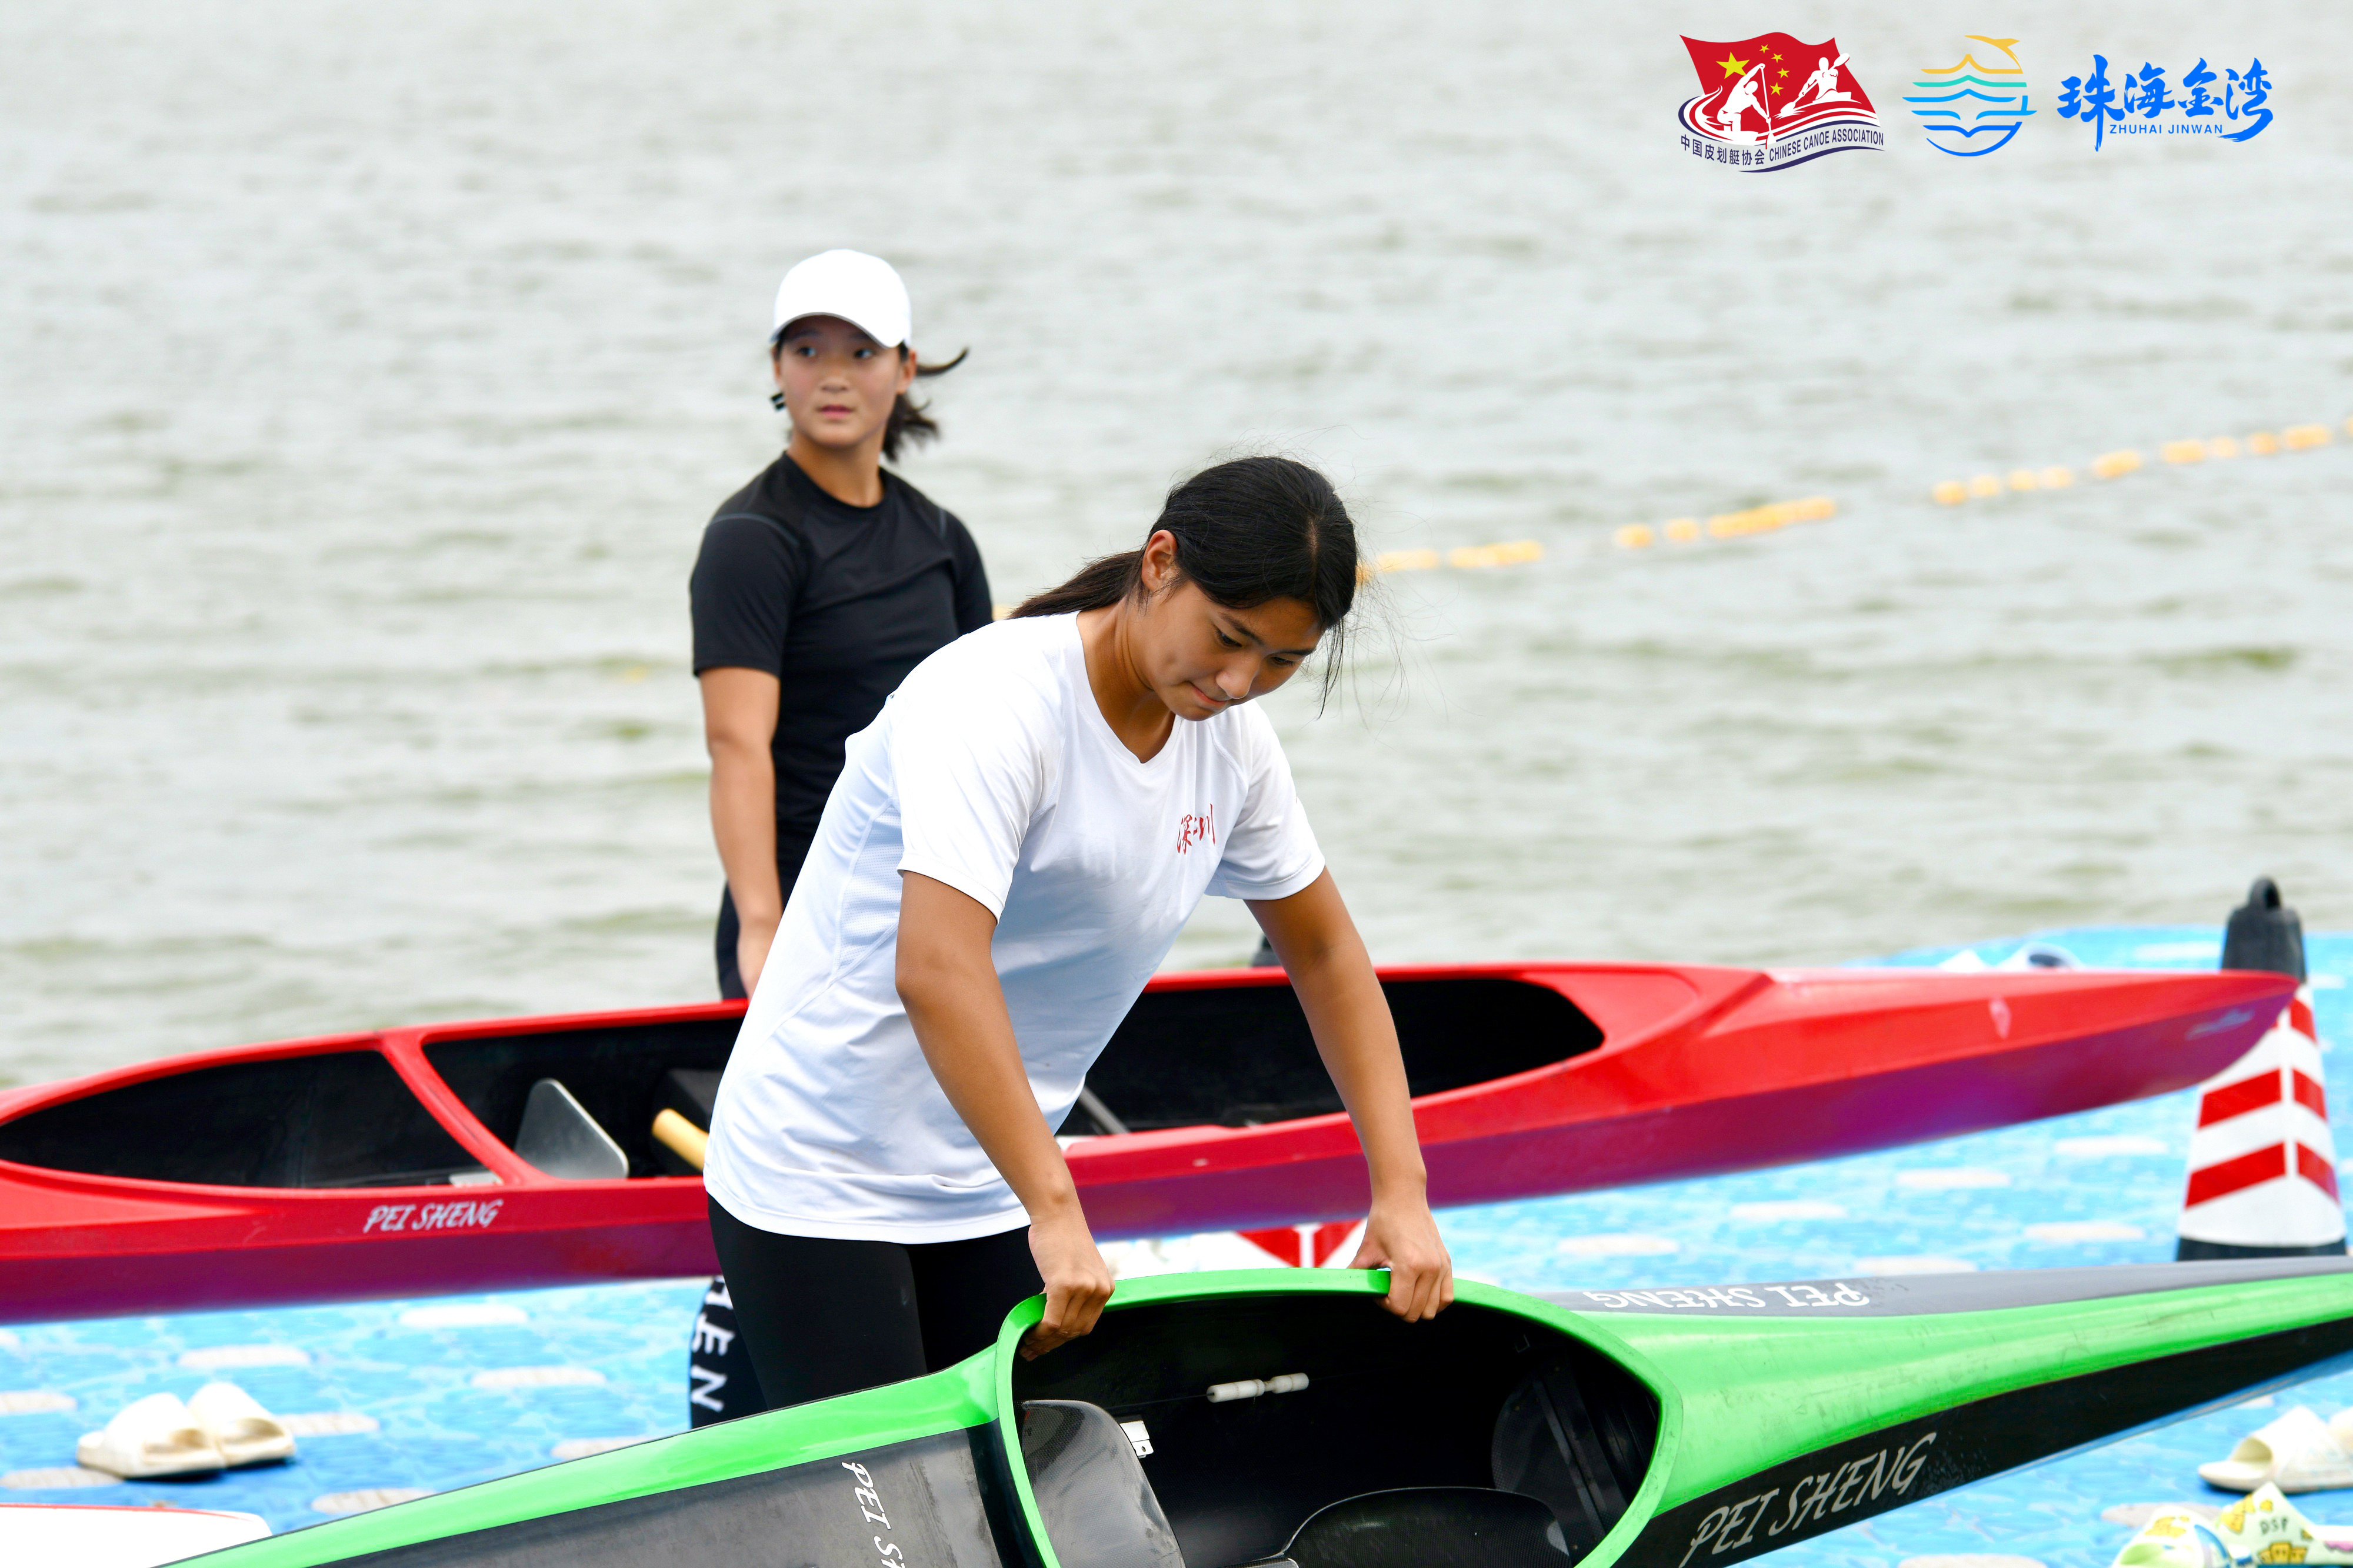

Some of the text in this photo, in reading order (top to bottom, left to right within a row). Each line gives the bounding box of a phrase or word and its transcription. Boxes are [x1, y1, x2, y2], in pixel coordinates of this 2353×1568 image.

[1177, 803, 1216, 855] 深圳
[362, 1199, 504, 1233] PEI SHENG
[1582, 1283, 1871, 1309] PEI SHENG
[841, 1462, 892, 1530] PEI
[1678, 1432, 1937, 1568] PEI SHENG
